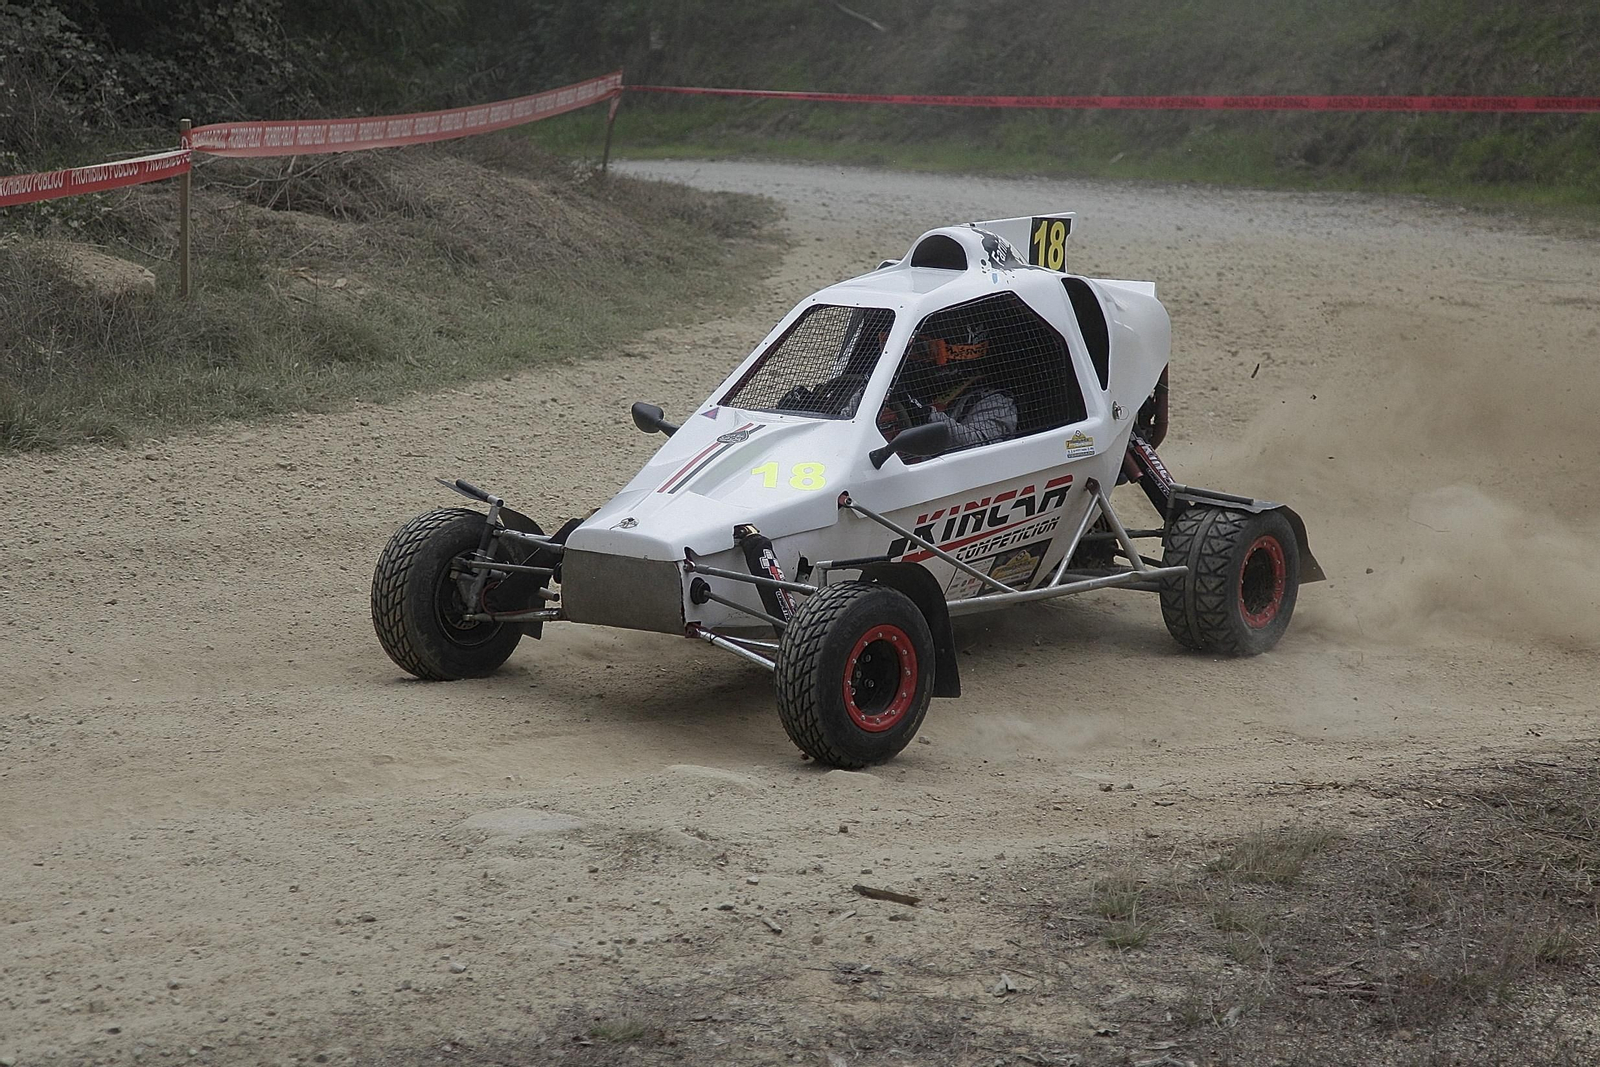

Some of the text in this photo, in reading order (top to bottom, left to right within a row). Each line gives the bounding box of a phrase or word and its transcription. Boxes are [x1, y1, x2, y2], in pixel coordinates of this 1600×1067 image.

[1034, 220, 1065, 270] 18
[751, 461, 826, 490] 18
[904, 474, 1074, 551] KINCAR
[957, 516, 1061, 561] COMPETICION
